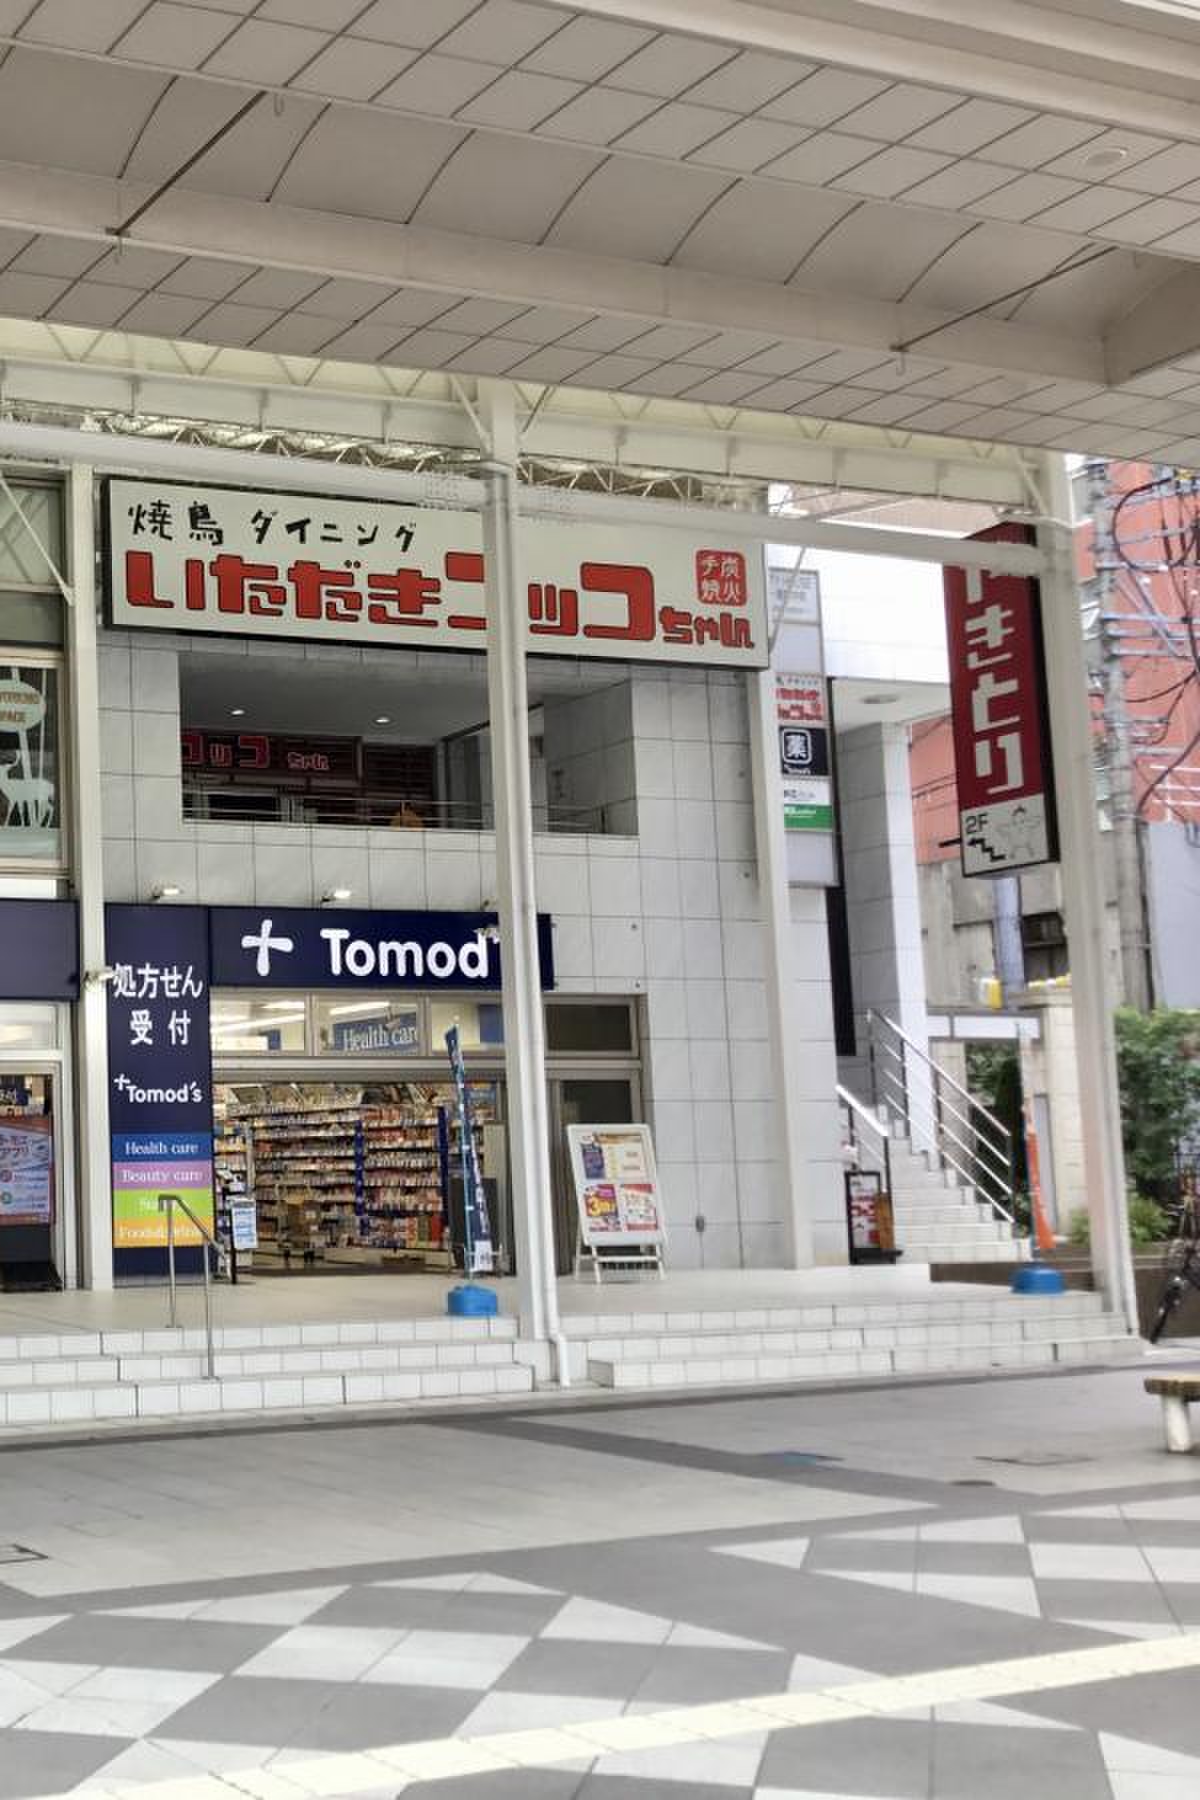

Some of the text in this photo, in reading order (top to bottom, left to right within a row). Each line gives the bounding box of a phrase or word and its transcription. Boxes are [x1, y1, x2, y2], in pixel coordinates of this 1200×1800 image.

[128, 500, 417, 552] 焼鳥 ダイニング
[965, 814, 989, 834] 2F
[320, 926, 500, 980] Tomod
[112, 962, 203, 999] 処方せん
[130, 1008, 192, 1046] 受付
[343, 1024, 417, 1052] Health car
[126, 1080, 203, 1104] Tomod's
[125, 1141, 199, 1156] Health care
[122, 1168, 171, 1184] Beauty
